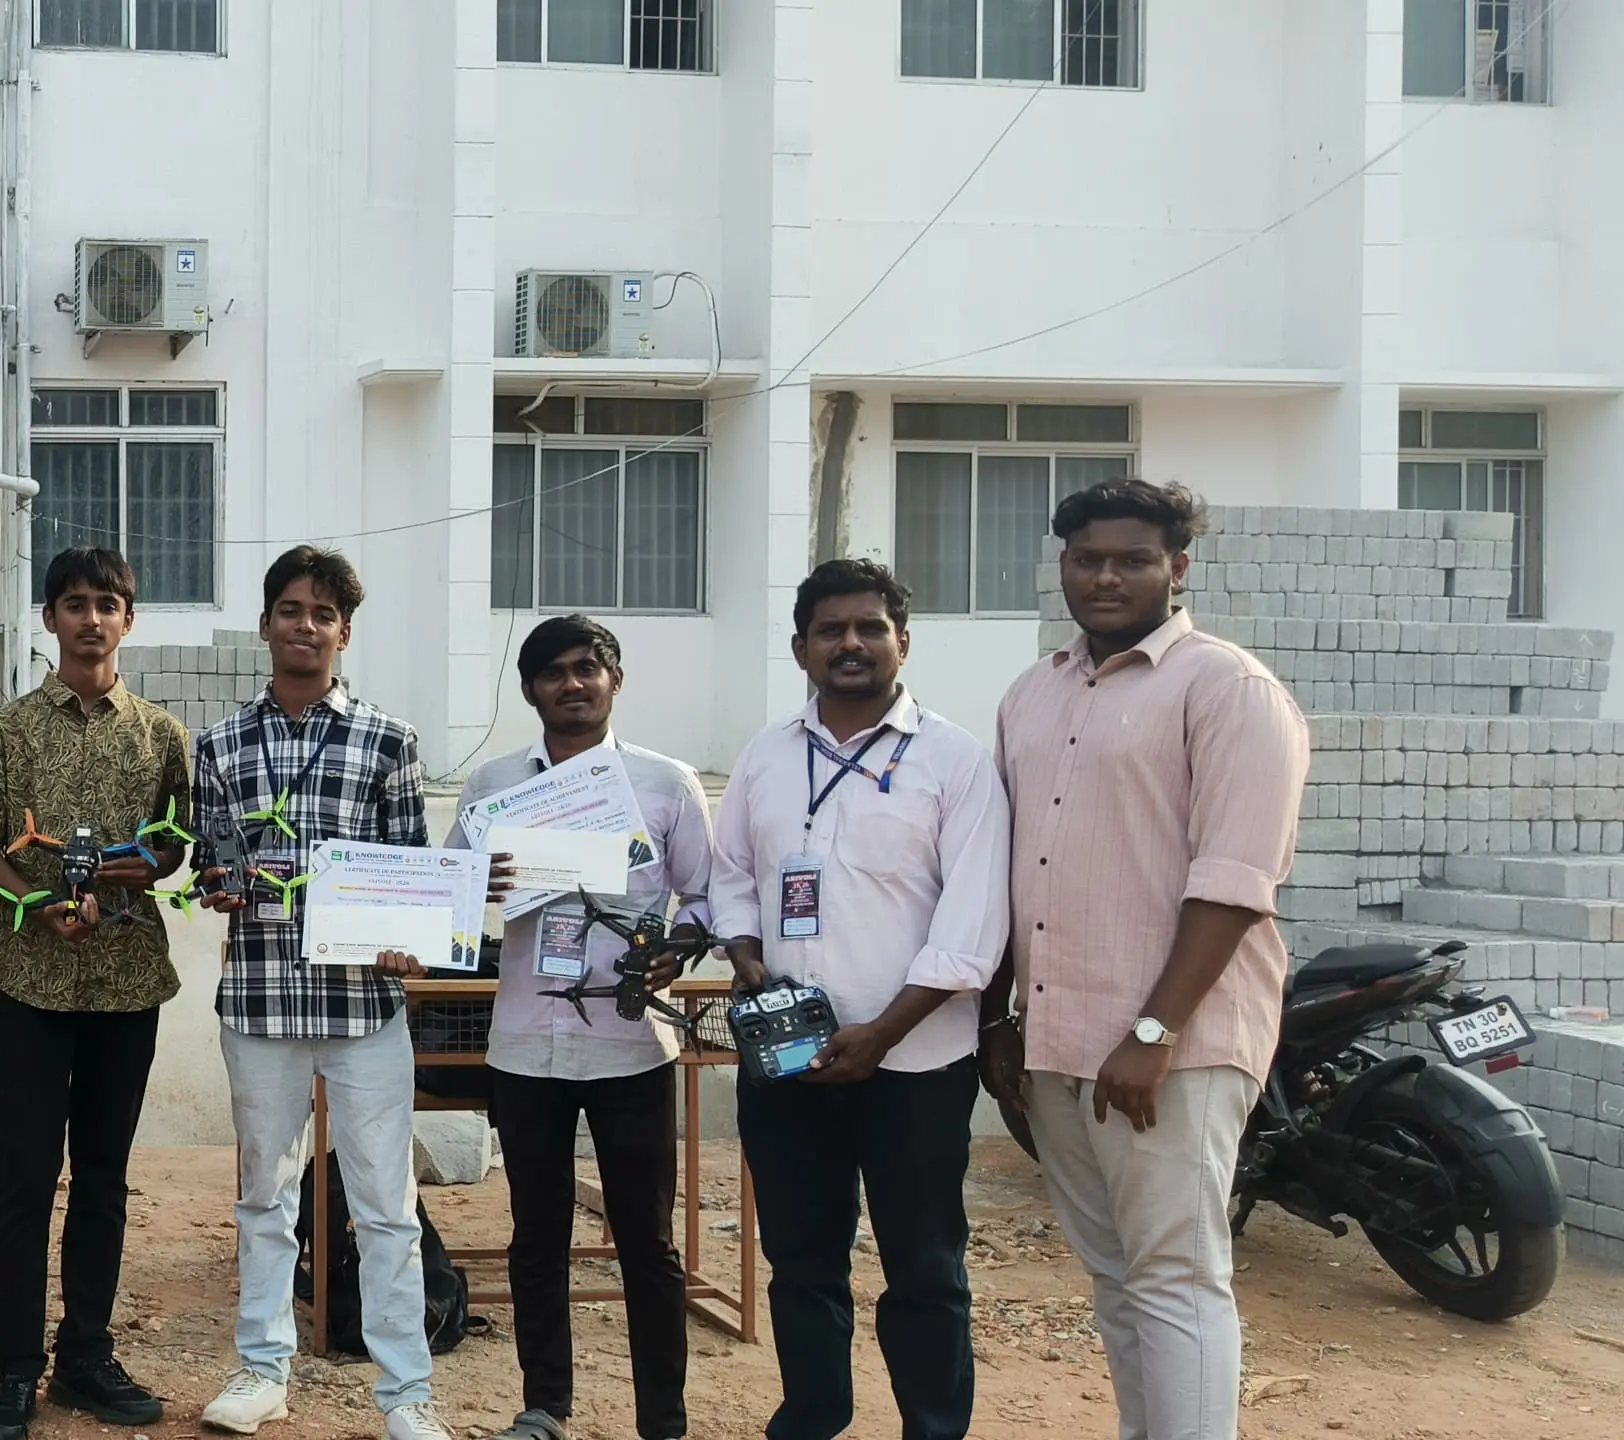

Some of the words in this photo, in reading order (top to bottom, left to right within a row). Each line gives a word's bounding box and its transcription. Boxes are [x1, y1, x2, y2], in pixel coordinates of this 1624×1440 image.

[1452, 1020, 1477, 1034] TN
[1477, 1011, 1498, 1026] 30
[1454, 1036, 1480, 1052] BQ
[1480, 1022, 1518, 1044] 5251
